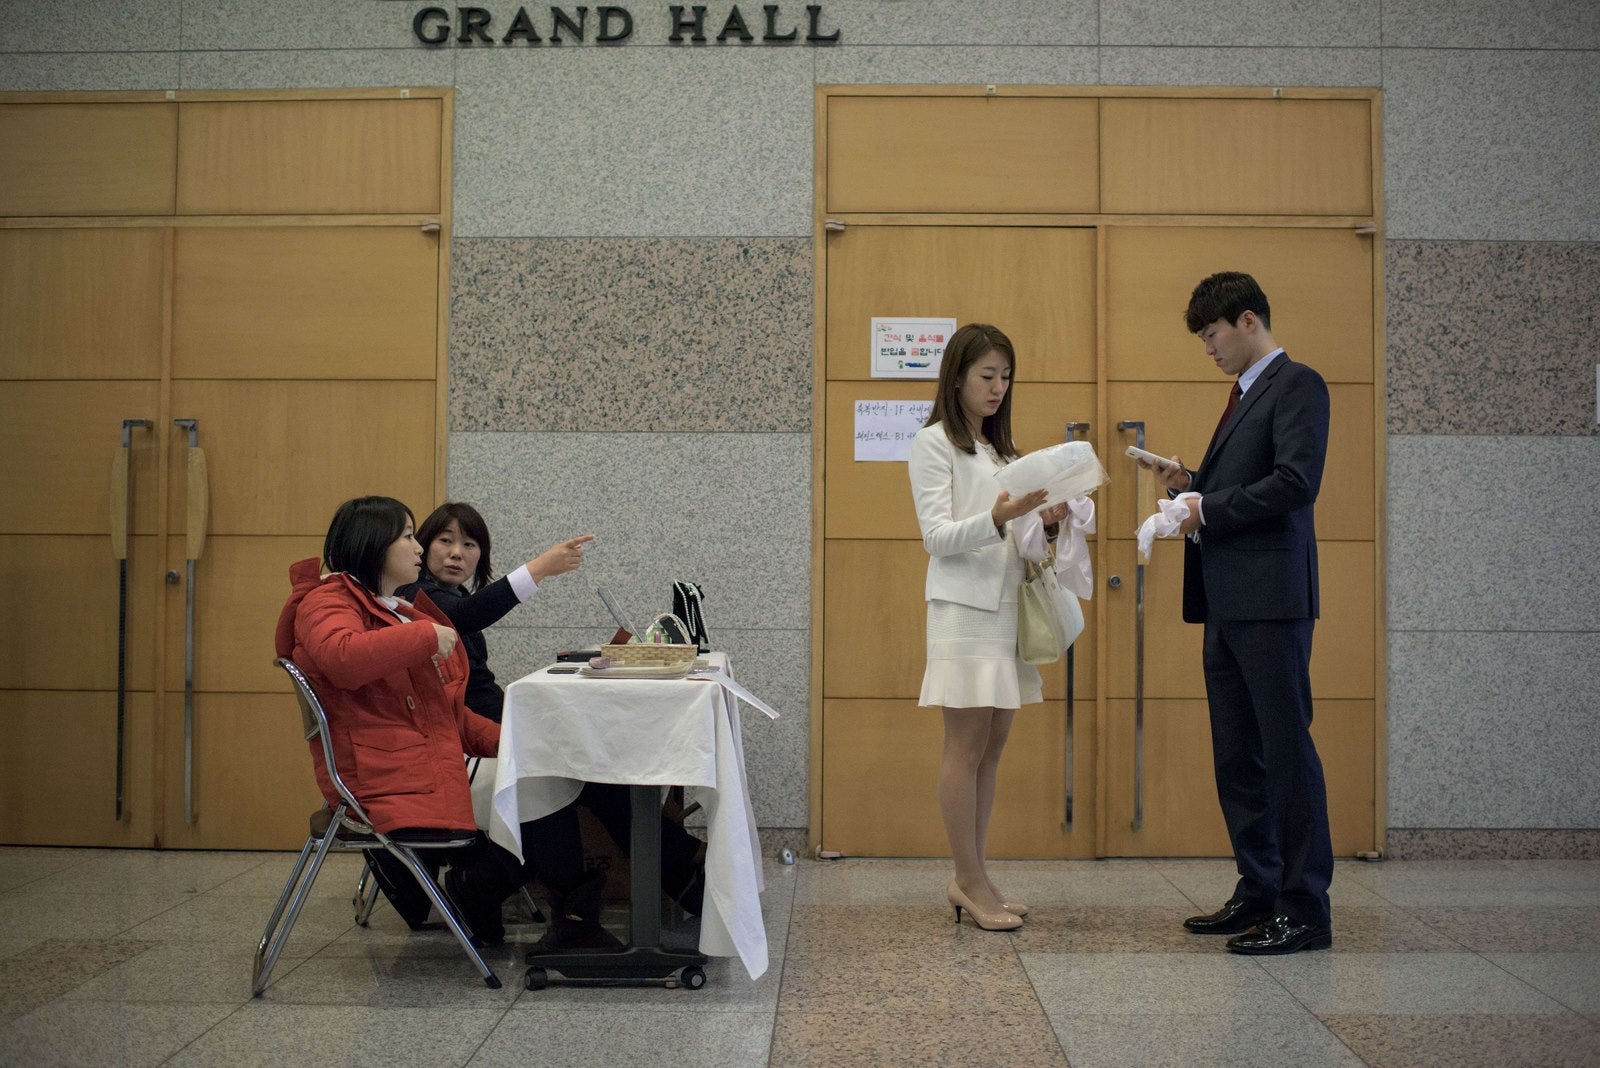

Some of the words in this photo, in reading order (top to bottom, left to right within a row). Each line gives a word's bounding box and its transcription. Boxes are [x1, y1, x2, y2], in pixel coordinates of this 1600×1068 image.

[413, 6, 633, 44] GRAND
[668, 4, 840, 42] HALL
[884, 333, 902, 342] 간식
[905, 333, 915, 343] 및
[918, 334, 944, 343] 음식물
[881, 347, 906, 356] 반입을
